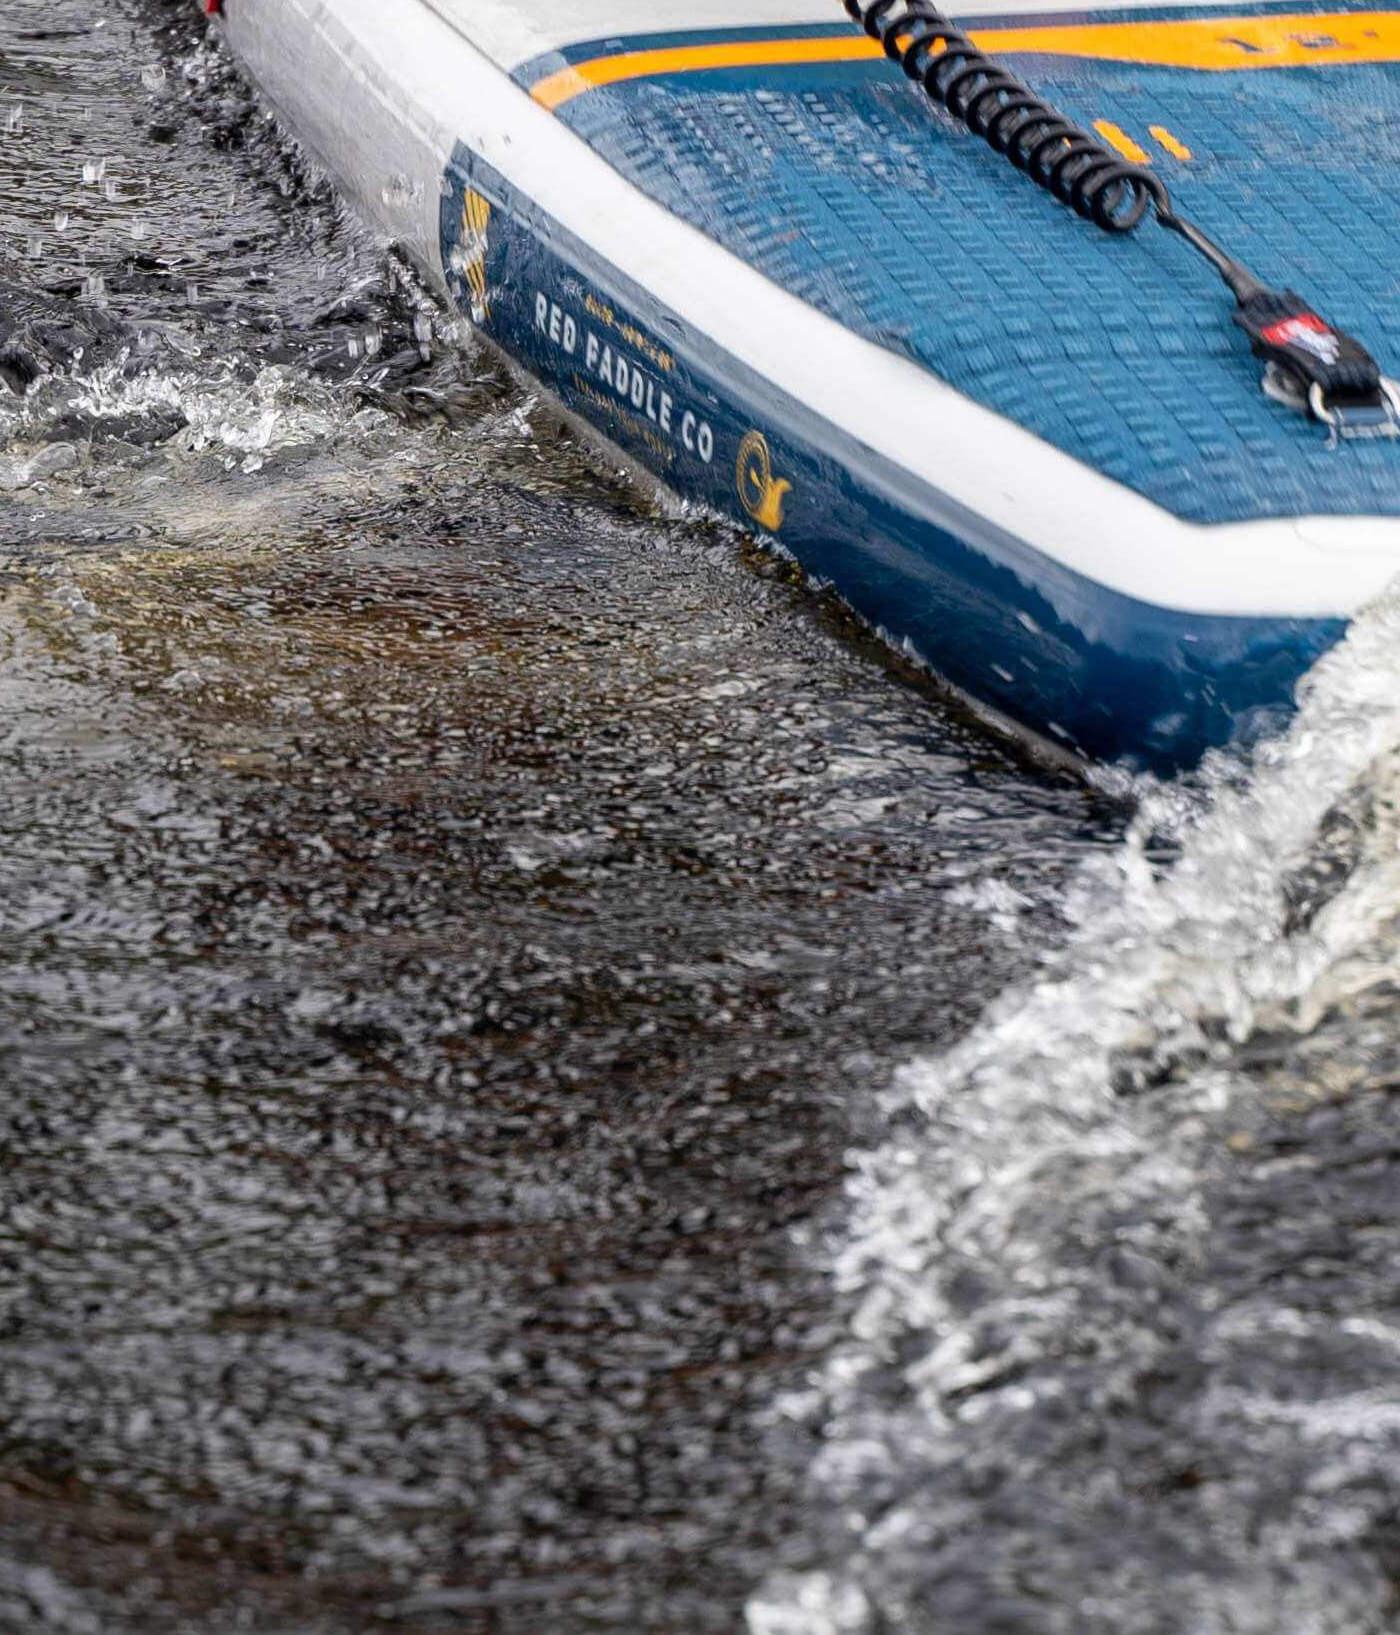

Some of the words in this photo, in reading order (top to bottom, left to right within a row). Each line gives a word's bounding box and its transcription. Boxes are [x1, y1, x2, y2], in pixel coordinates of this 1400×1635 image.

[535, 290, 576, 355] RED
[586, 331, 674, 435] PADDLE
[681, 409, 714, 464] CO
